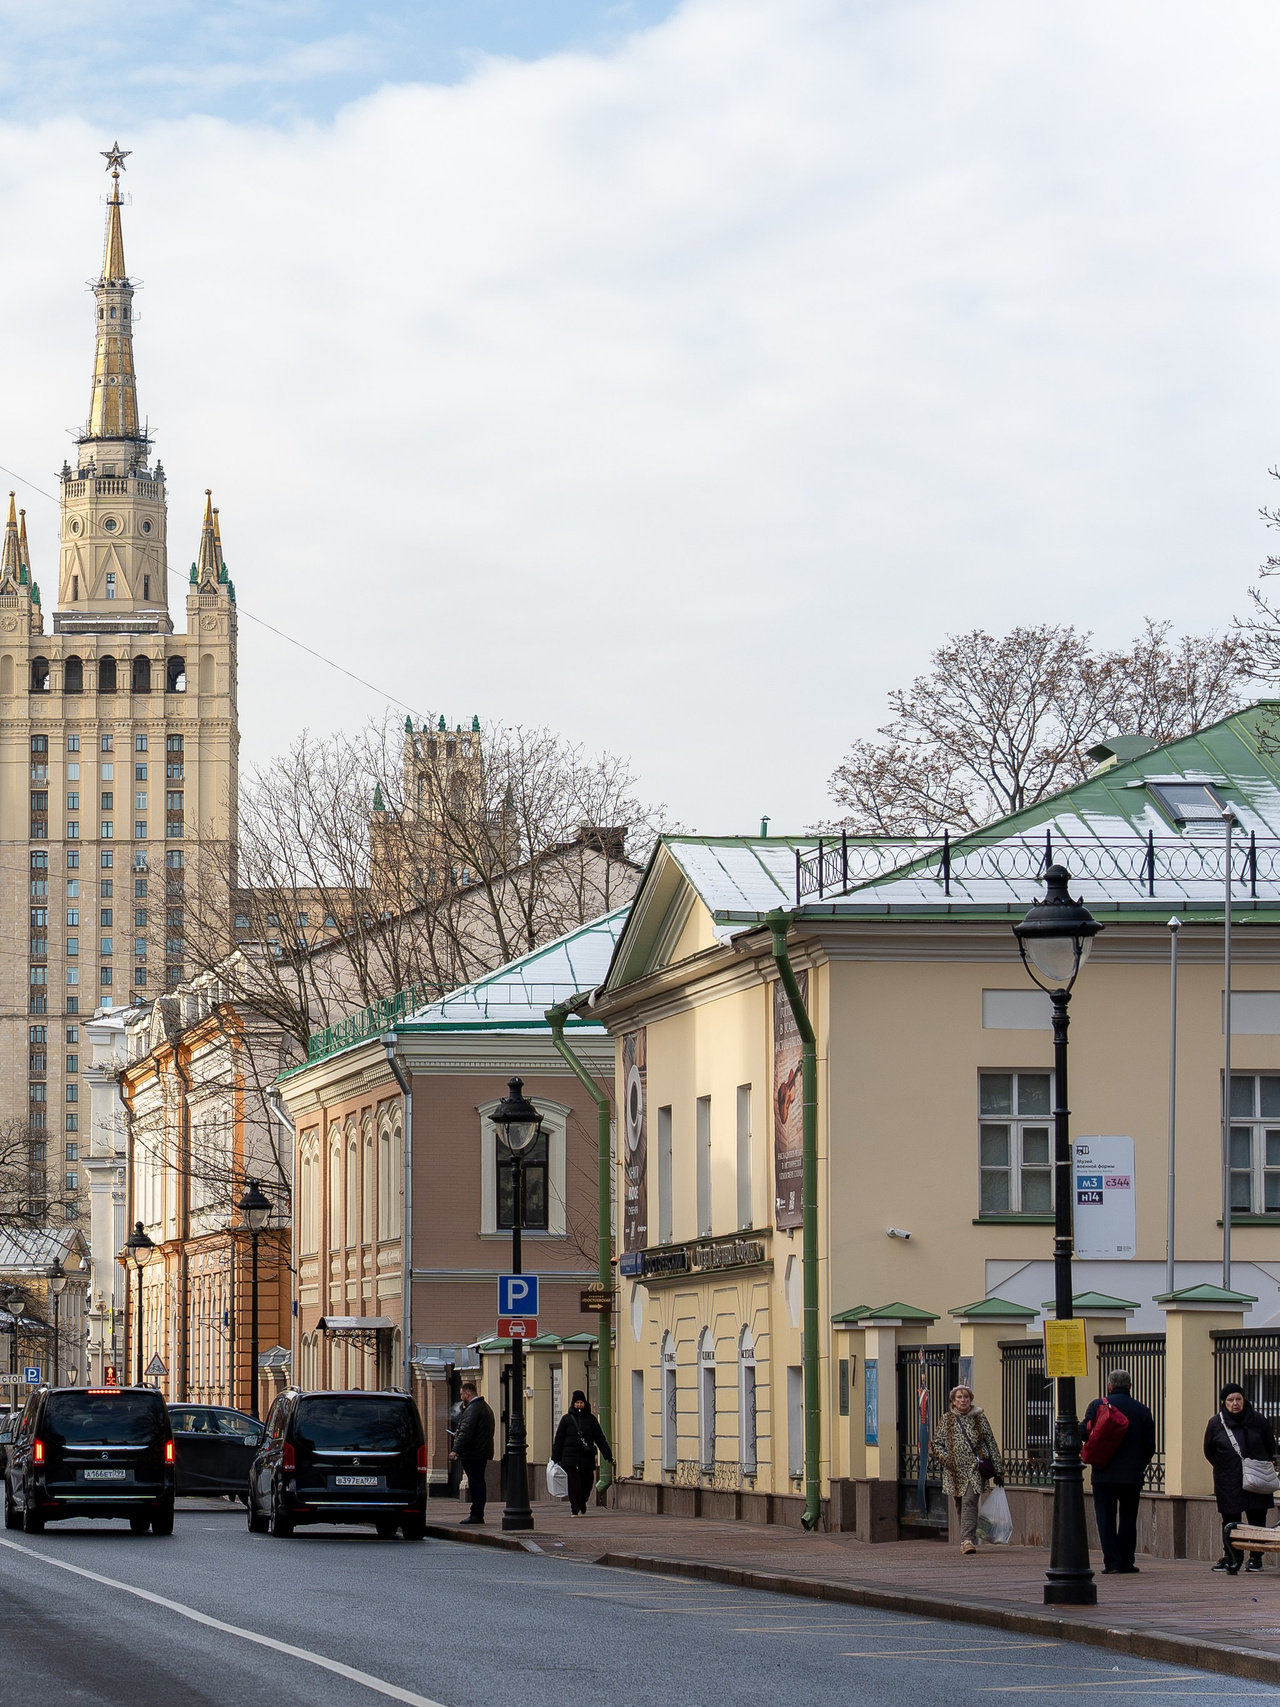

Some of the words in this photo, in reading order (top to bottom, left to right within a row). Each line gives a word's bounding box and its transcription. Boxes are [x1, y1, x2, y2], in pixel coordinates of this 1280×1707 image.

[1082, 1178, 1098, 1187] м3
[1105, 1178, 1130, 1187] с344
[1081, 1192, 1100, 1201] н14
[508, 1280, 529, 1309] P
[1, 1375, 23, 1383] СТОП
